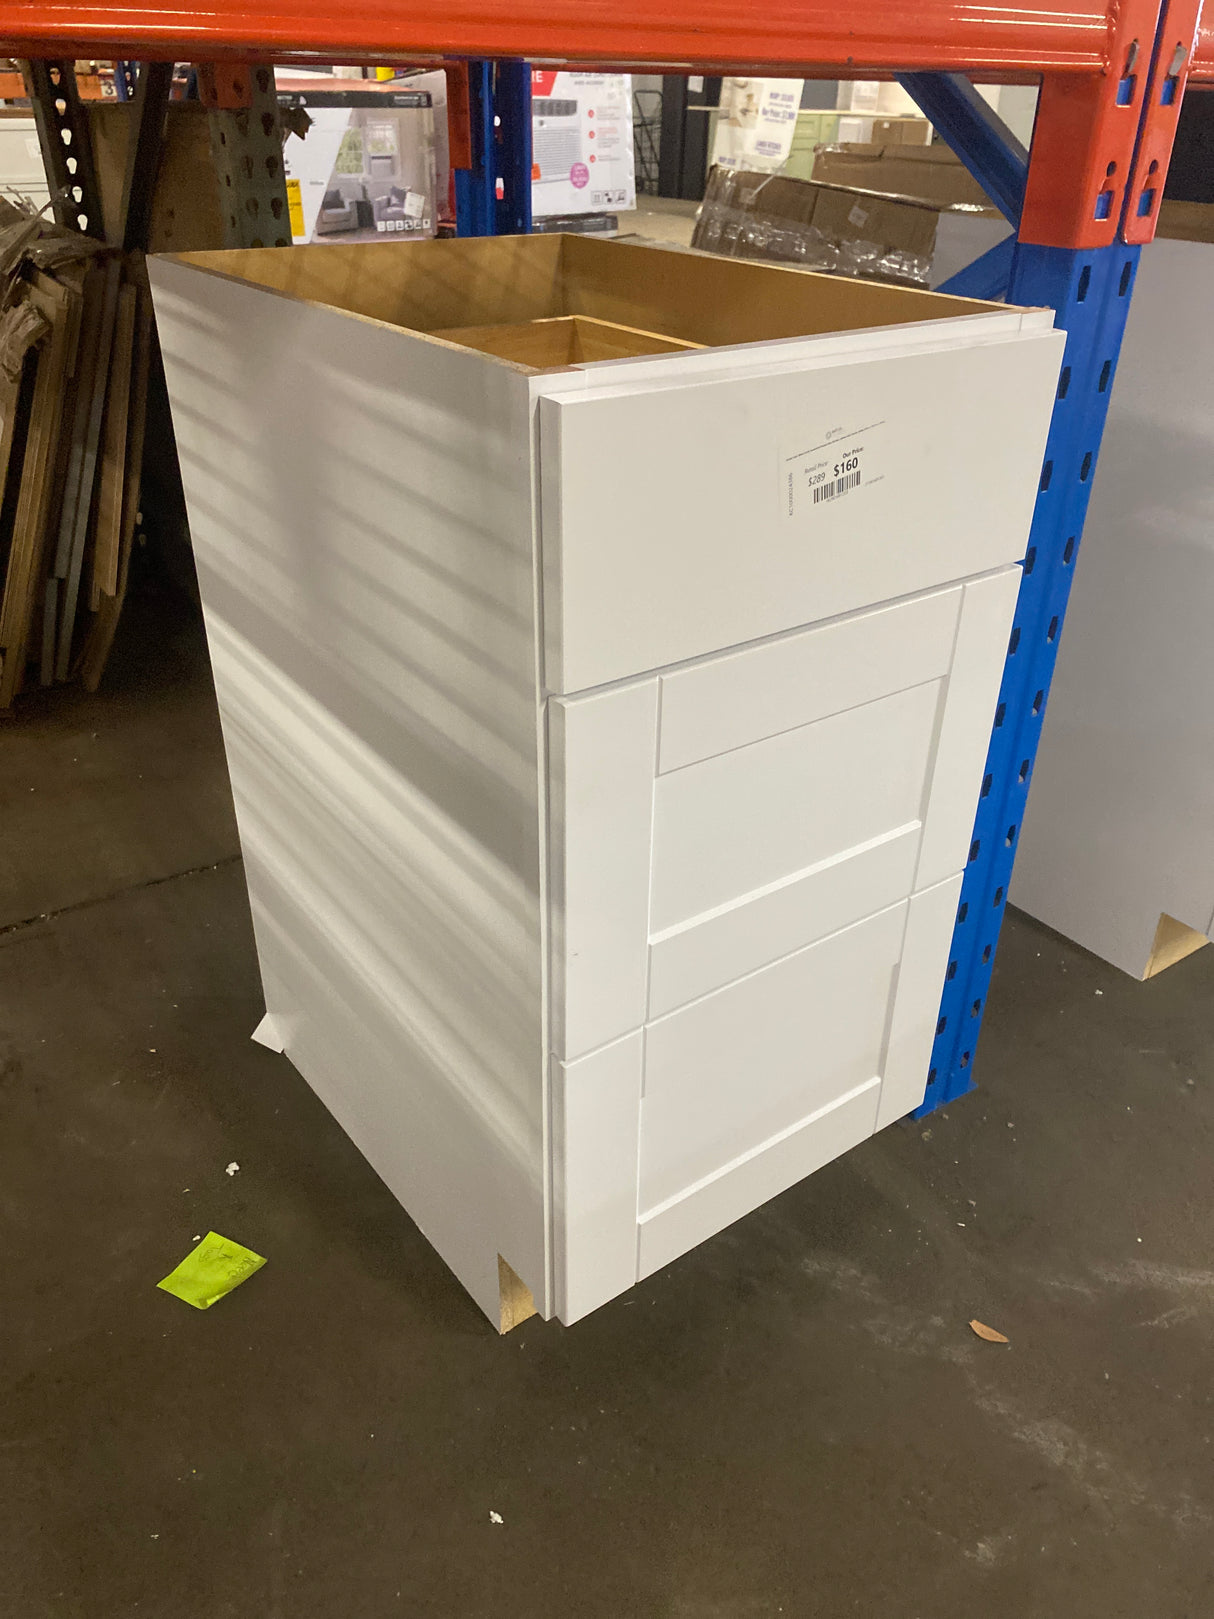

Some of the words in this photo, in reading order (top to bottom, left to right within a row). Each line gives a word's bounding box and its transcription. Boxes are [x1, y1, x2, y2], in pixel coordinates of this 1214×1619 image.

[842, 451, 852, 459] Our
[833, 457, 859, 477] $160
[808, 471, 826, 487] $289
